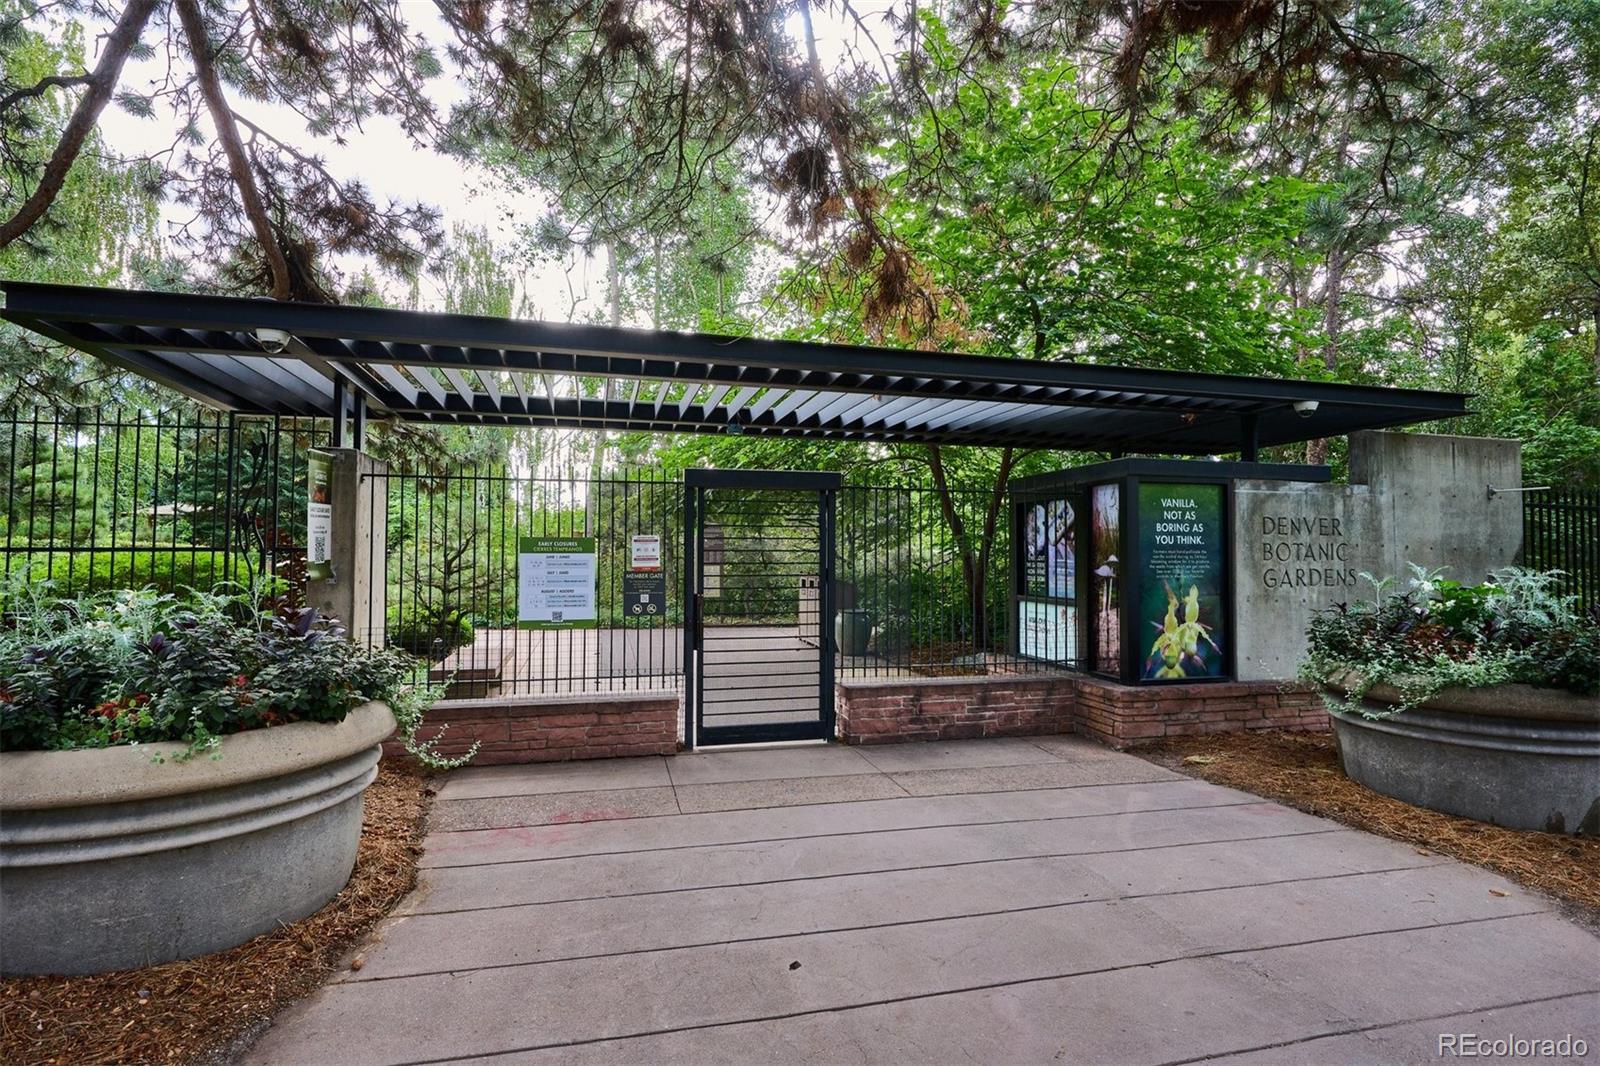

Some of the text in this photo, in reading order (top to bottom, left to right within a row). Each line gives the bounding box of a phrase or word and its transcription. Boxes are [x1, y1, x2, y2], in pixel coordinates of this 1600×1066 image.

[1160, 498, 1198, 508] VANILLA.
[1164, 511, 1196, 520] NOT AS
[1156, 523, 1204, 532] BORING AS
[1262, 516, 1342, 536] DENVER
[1155, 535, 1205, 544] YOU THINK.
[1263, 542, 1348, 562] BOTANIC
[1263, 568, 1357, 588] GARDENS
